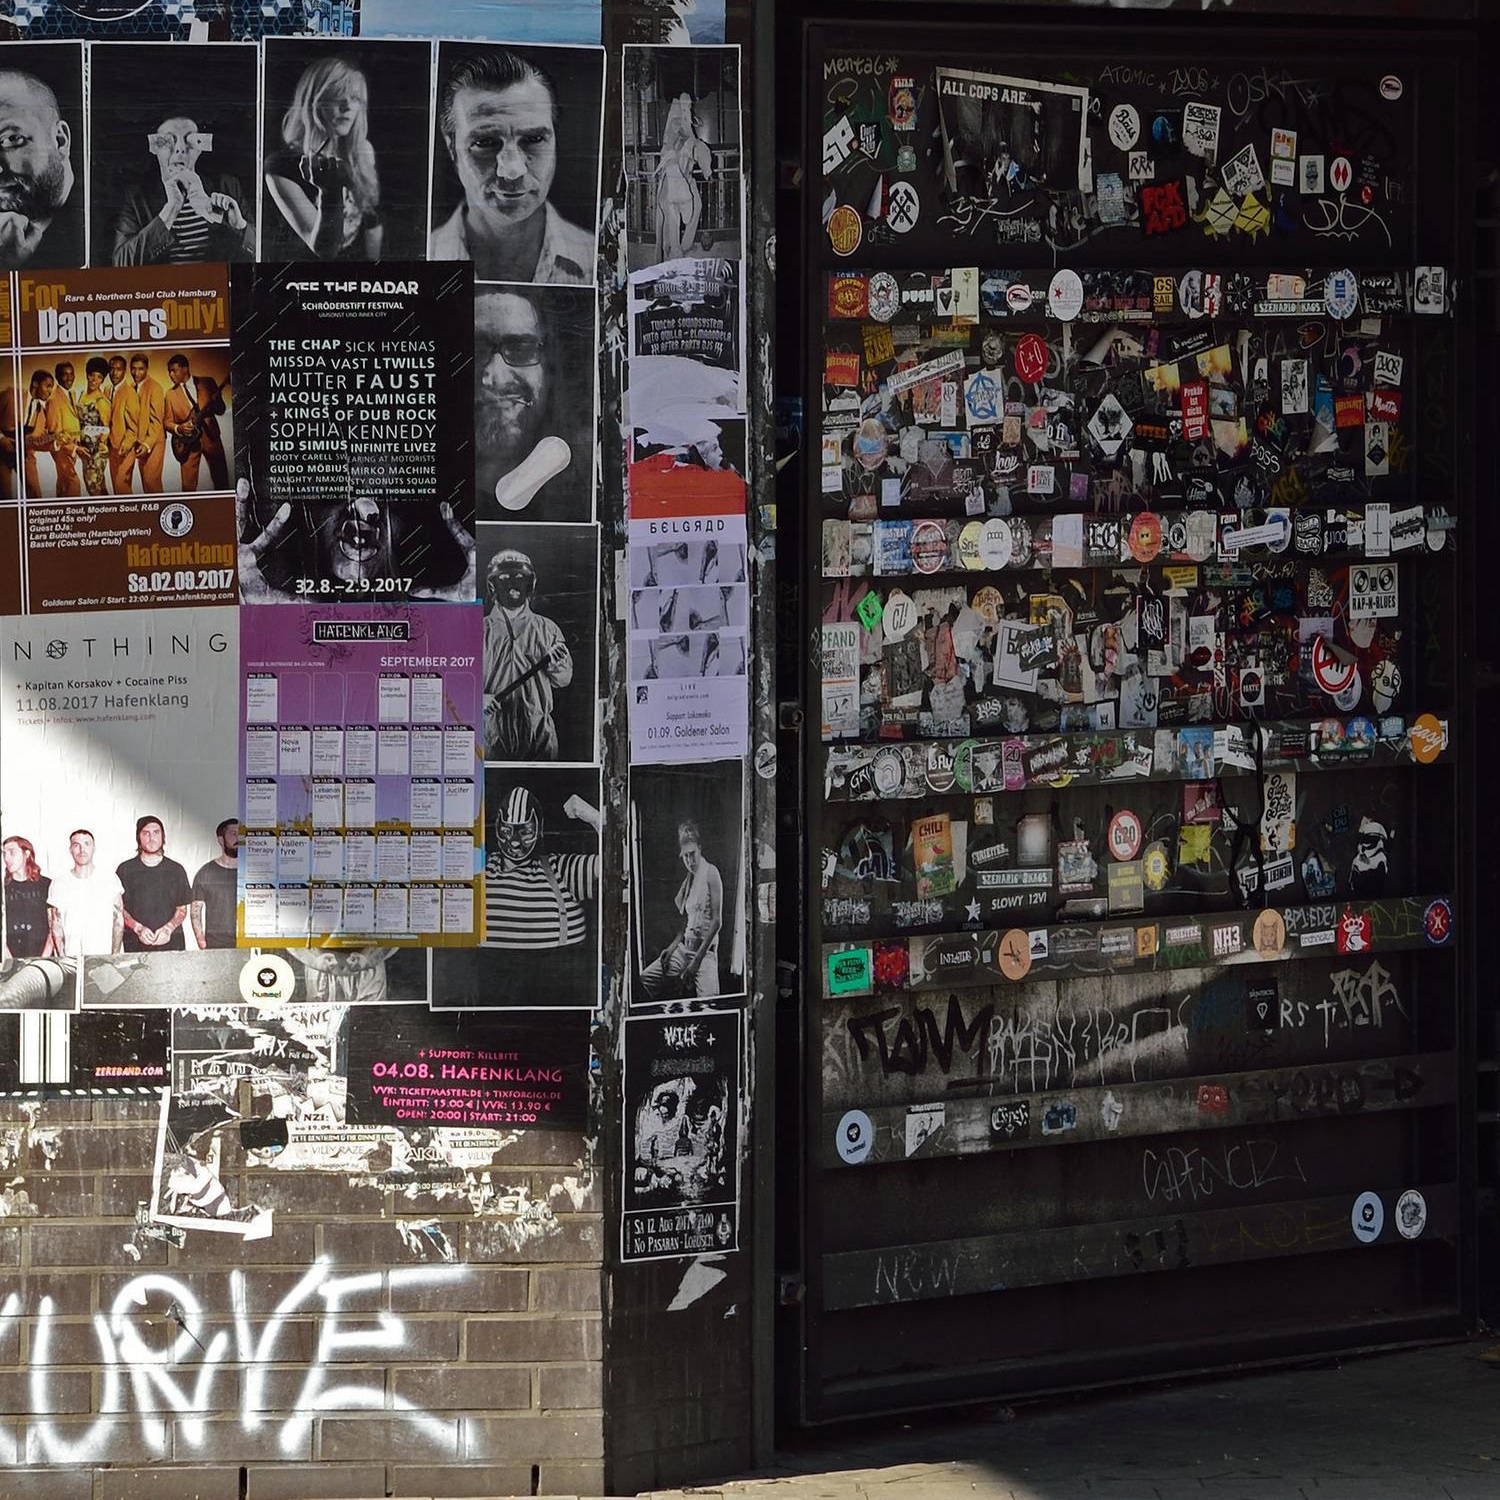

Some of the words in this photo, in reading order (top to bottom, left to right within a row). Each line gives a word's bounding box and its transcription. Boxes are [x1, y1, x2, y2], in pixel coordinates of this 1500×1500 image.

[942, 80, 965, 96] ALL
[969, 83, 998, 101] COPS
[21, 279, 67, 311] For
[65, 293, 85, 303] Rare
[95, 291, 134, 301] Northern
[135, 290, 155, 301] Soul
[156, 289, 176, 299] Club
[177, 288, 217, 299] Hamburg
[361, 281, 419, 295] RADAR
[368, 301, 404, 310] FESTIVAL
[38, 306, 168, 344] Dancers
[162, 298, 225, 334] Only!
[269, 340, 296, 351] THE
[301, 339, 341, 351] CHAP
[345, 341, 375, 353] SICK
[381, 341, 436, 352] HYENAS
[269, 356, 326, 368] MISSDA
[331, 358, 368, 370] VAST
[270, 372, 347, 390] MUTTER
[356, 373, 436, 389] FAUST
[269, 392, 339, 406] JACQUES
[346, 393, 436, 405] PALMINGER
[284, 407, 329, 419] KINGS
[335, 410, 354, 422] OF
[360, 409, 391, 421] DUB
[396, 409, 436, 421] ROCK
[270, 422, 340, 439] SOPHIA
[349, 424, 437, 440] KENNEDY
[270, 440, 295, 451] KID
[300, 439, 348, 451] SIMIUS
[351, 442, 400, 453] INFINITE
[404, 442, 436, 453] LIVEZ
[270, 464, 304, 474] GUIDO
[307, 463, 348, 474] MÖBIUS
[351, 466, 385, 476] MIRKO
[388, 466, 436, 476] MACHINE
[127, 542, 234, 568] Hafenklang
[380, 656, 448, 667] SEPTEMBER
[449, 656, 475, 667] 2017
[25, 680, 64, 692] Kapitan
[67, 678, 113, 690] Korsakov
[125, 676, 165, 687] Cocaine
[168, 675, 188, 686] Piss
[16, 695, 99, 712] 11.08.2017
[104, 693, 189, 709] Hafenklang
[991, 894, 1024, 911] SLOWY
[429, 1049, 475, 1060] SUPPORT:
[372, 1062, 434, 1079] 04.08.
[441, 1064, 562, 1083] HAFENKLANG
[373, 1085, 397, 1095] VVK:
[396, 1109, 427, 1119] OPEN:
[430, 1110, 461, 1120] 20:00
[469, 1111, 502, 1122] START:
[505, 1112, 536, 1123] 21:00
